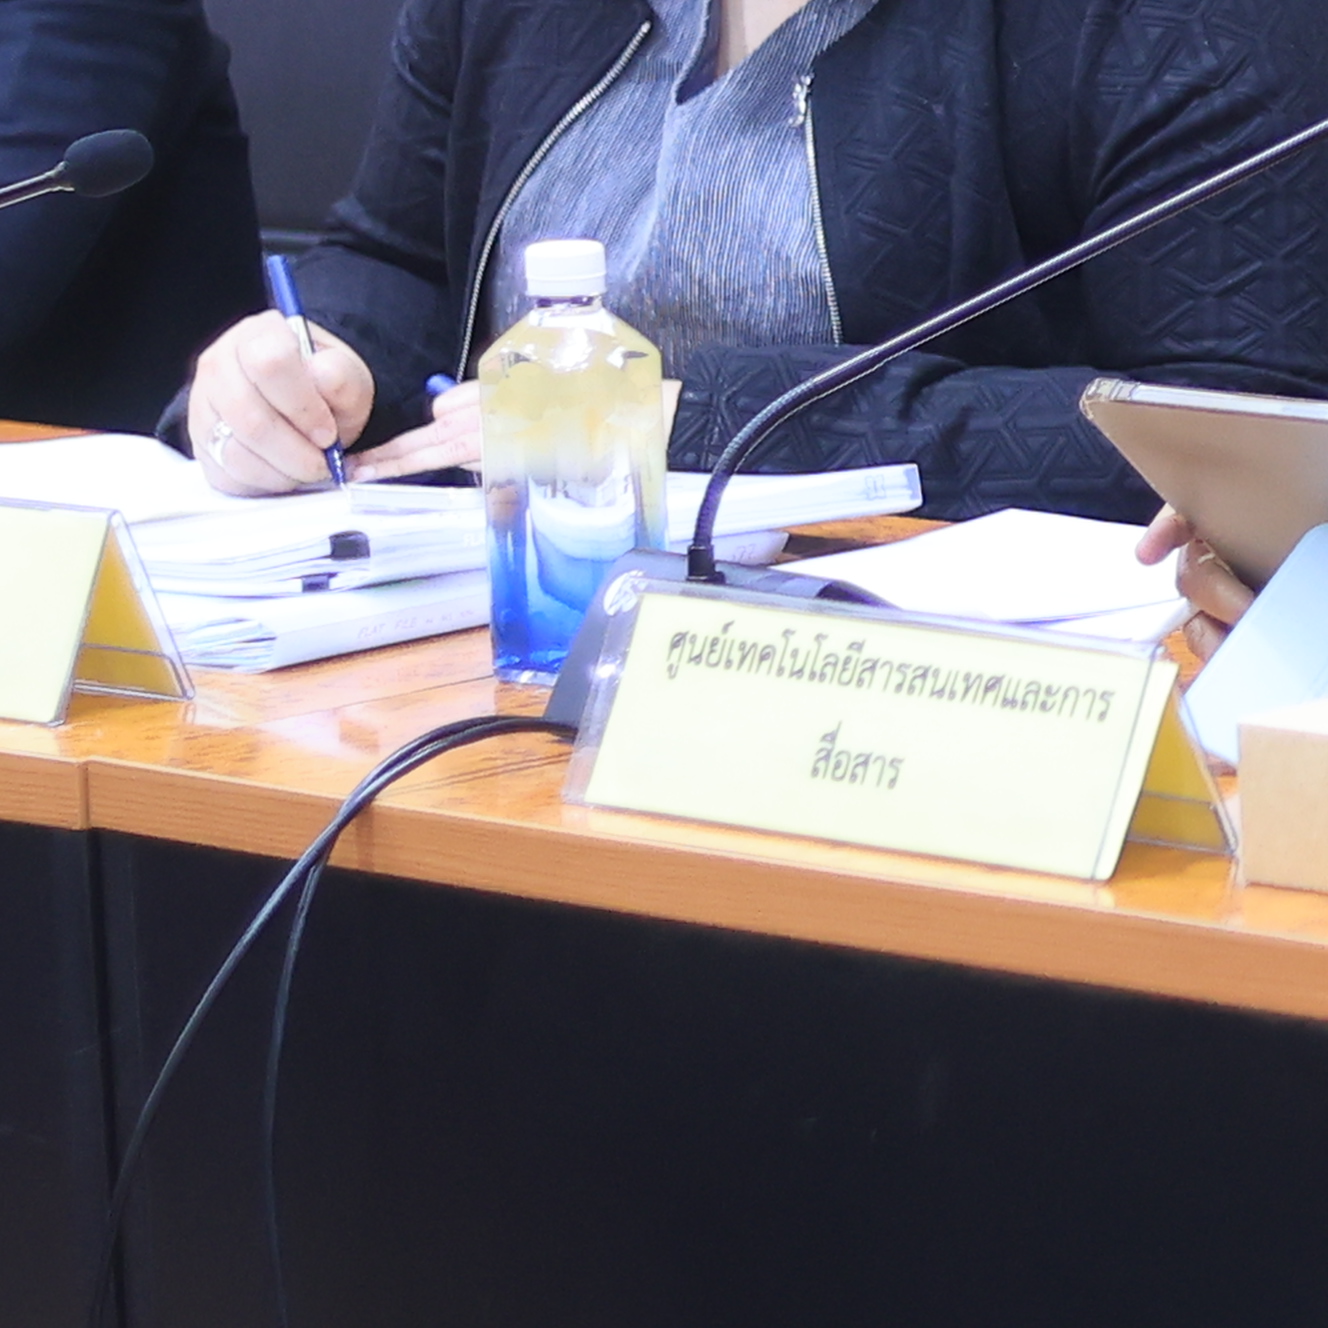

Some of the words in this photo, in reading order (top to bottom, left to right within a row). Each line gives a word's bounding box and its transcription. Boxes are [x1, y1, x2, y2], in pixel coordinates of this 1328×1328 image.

[666, 620, 1115, 722] ศูนย์เทคโนโลยีสารสนเทศและการ
[810, 722, 904, 789] สื่อสาร
